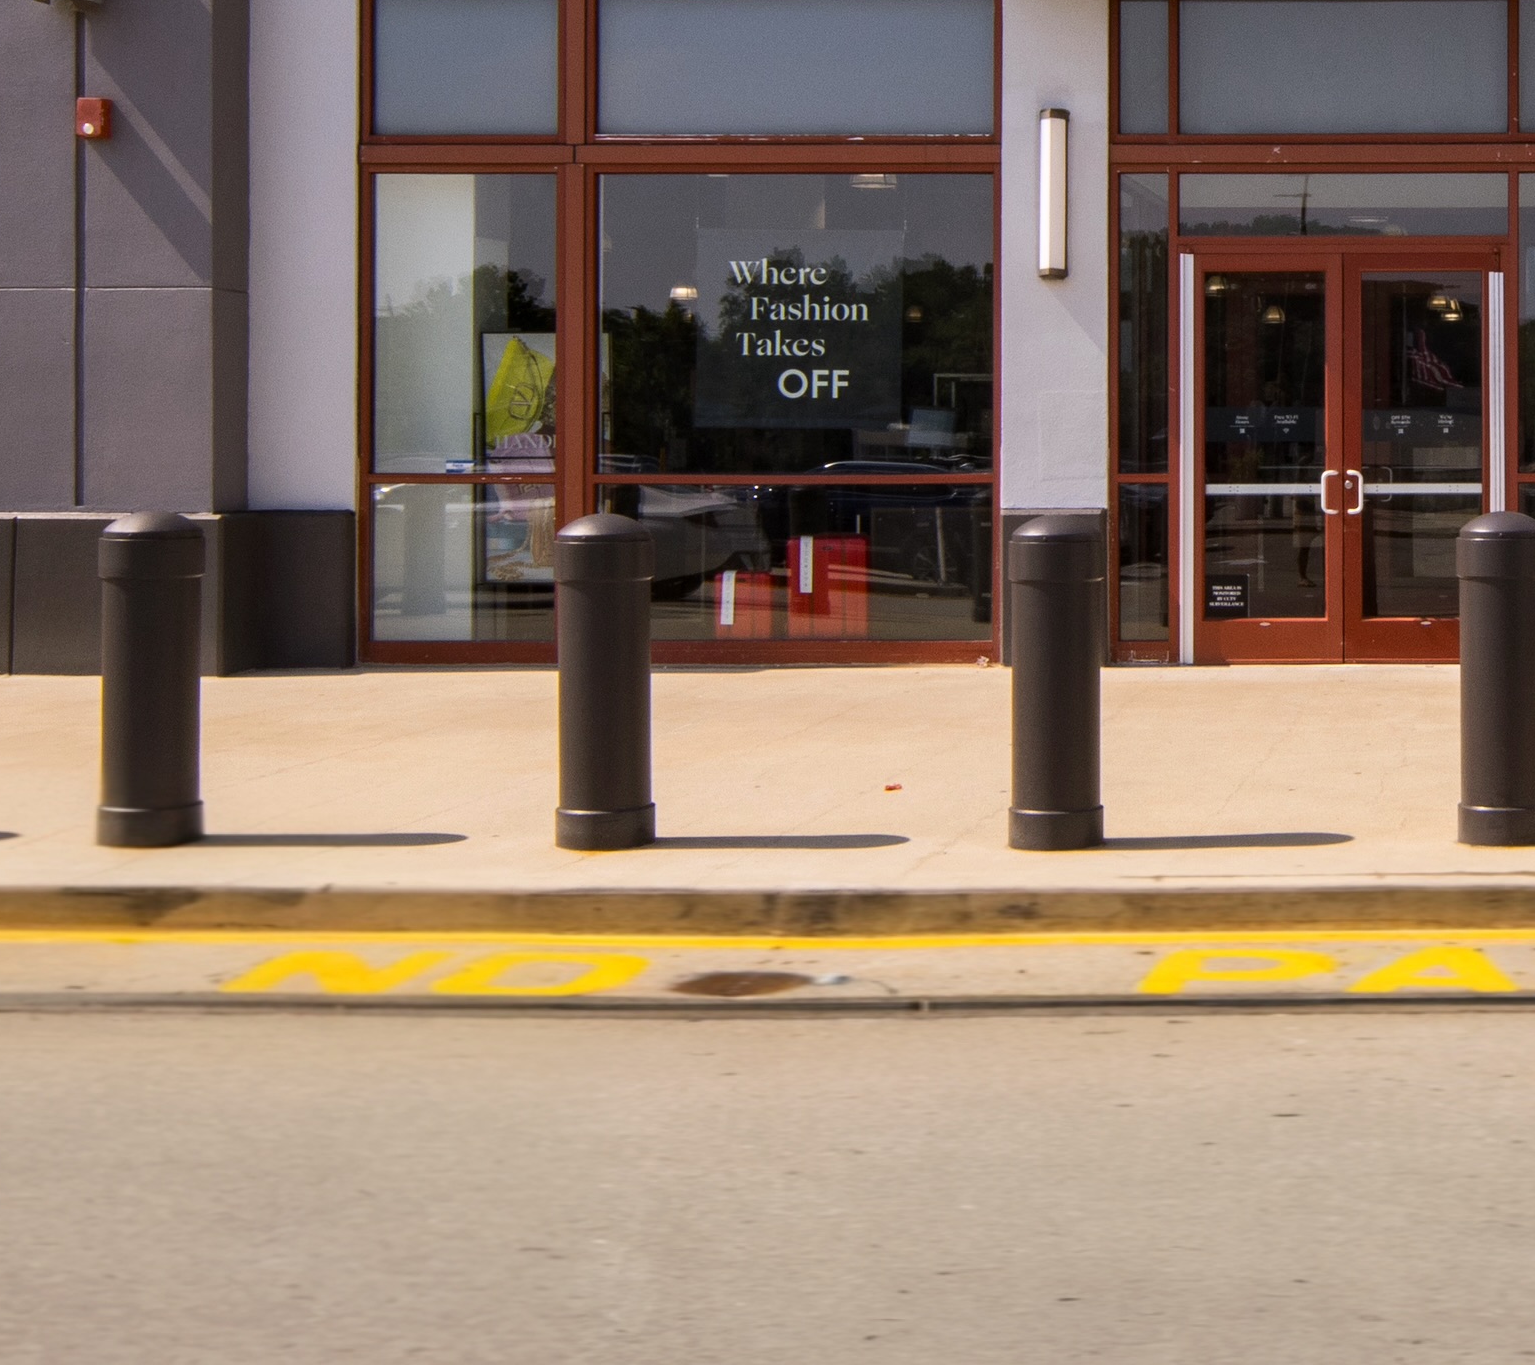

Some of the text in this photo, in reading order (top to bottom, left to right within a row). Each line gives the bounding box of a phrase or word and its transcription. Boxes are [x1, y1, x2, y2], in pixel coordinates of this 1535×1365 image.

[728, 257, 829, 285] Where
[750, 293, 870, 321] Fashion
[735, 329, 826, 357] Takes
[777, 368, 850, 399] OFF
[217, 948, 650, 997] NO
